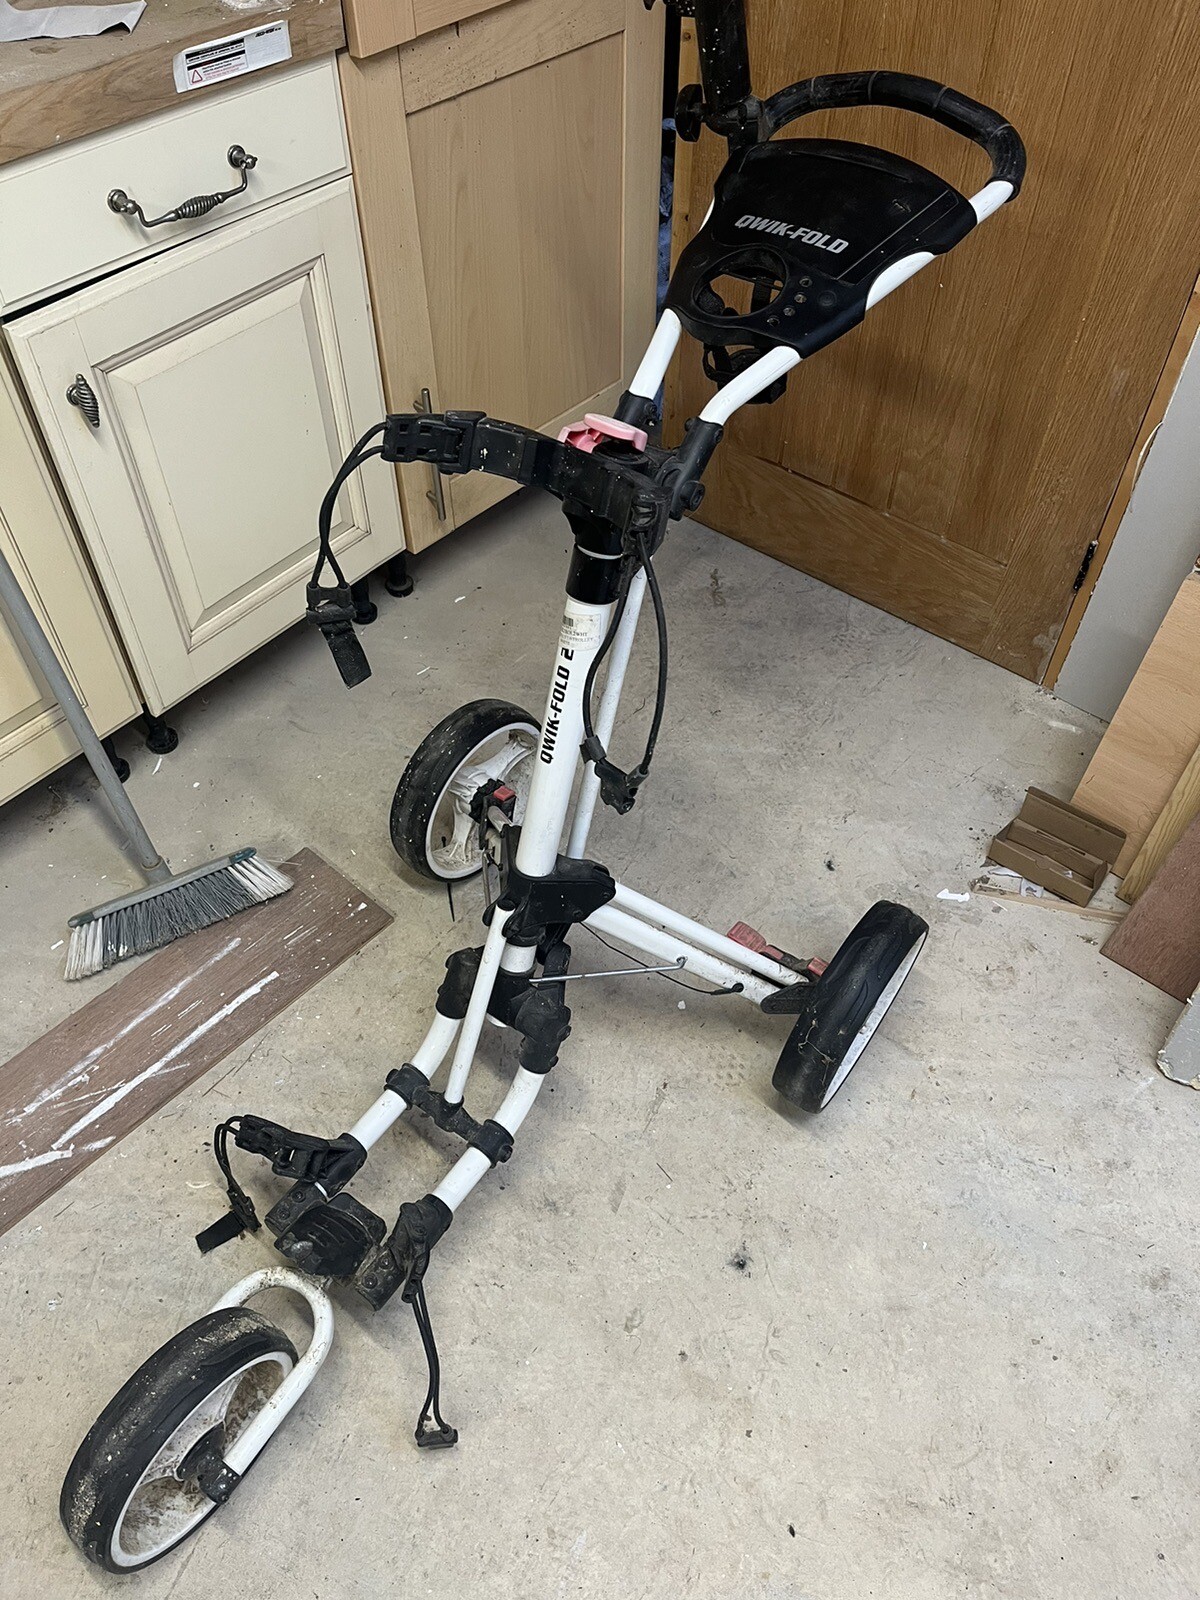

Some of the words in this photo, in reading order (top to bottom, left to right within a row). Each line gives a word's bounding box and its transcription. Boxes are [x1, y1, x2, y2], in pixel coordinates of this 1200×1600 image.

[734, 214, 849, 254] QWIK-FOLD
[540, 665, 570, 764] QWIK-FOLD
[560, 647, 574, 661] 2
